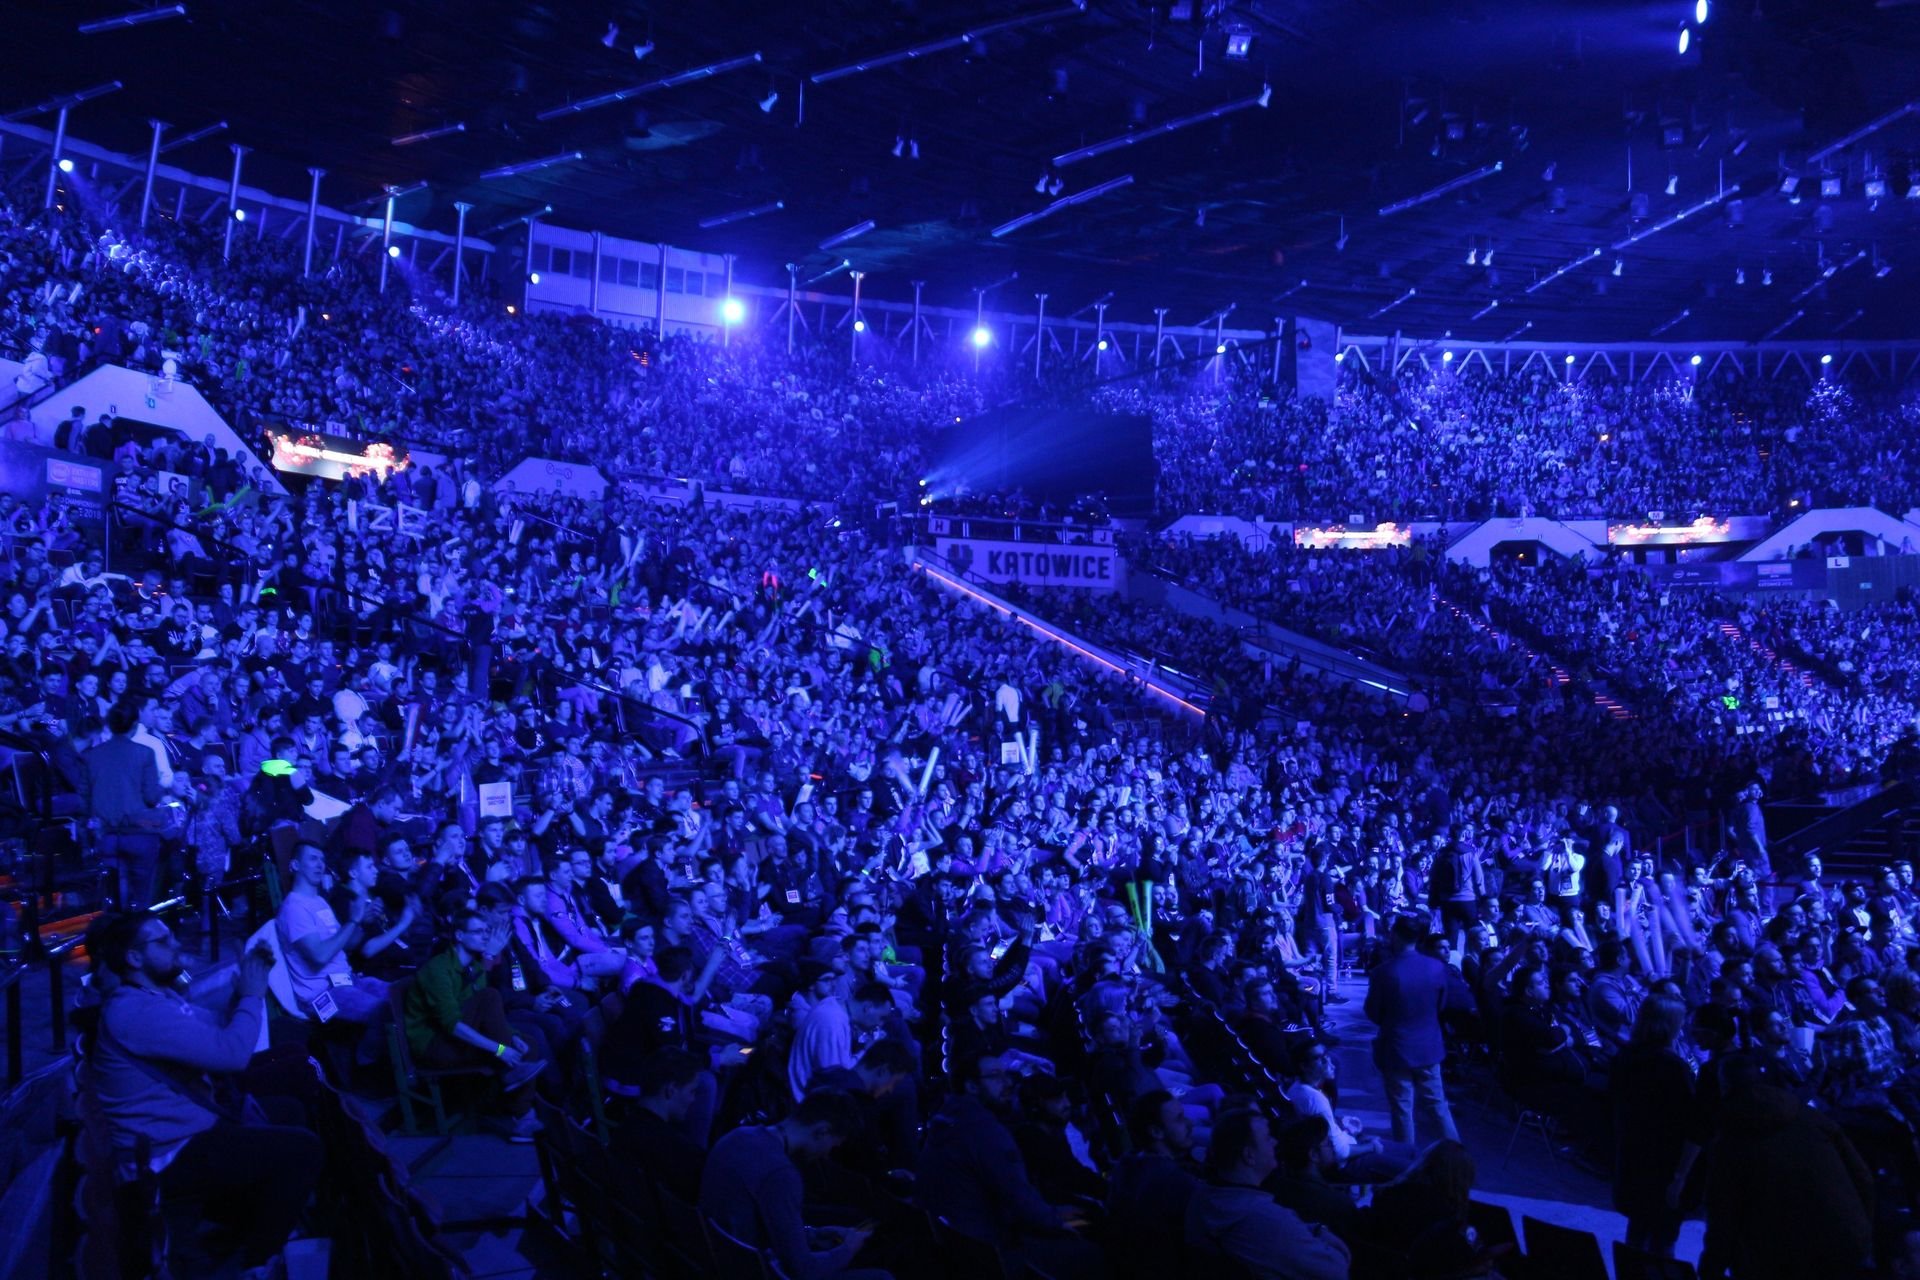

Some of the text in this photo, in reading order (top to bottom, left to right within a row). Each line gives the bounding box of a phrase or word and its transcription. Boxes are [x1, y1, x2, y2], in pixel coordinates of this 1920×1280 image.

[332, 424, 340, 434] H
[935, 521, 943, 531] H
[1100, 532, 1106, 542] J
[988, 550, 1110, 579] KATOWICE
[1834, 558, 1842, 567] L
